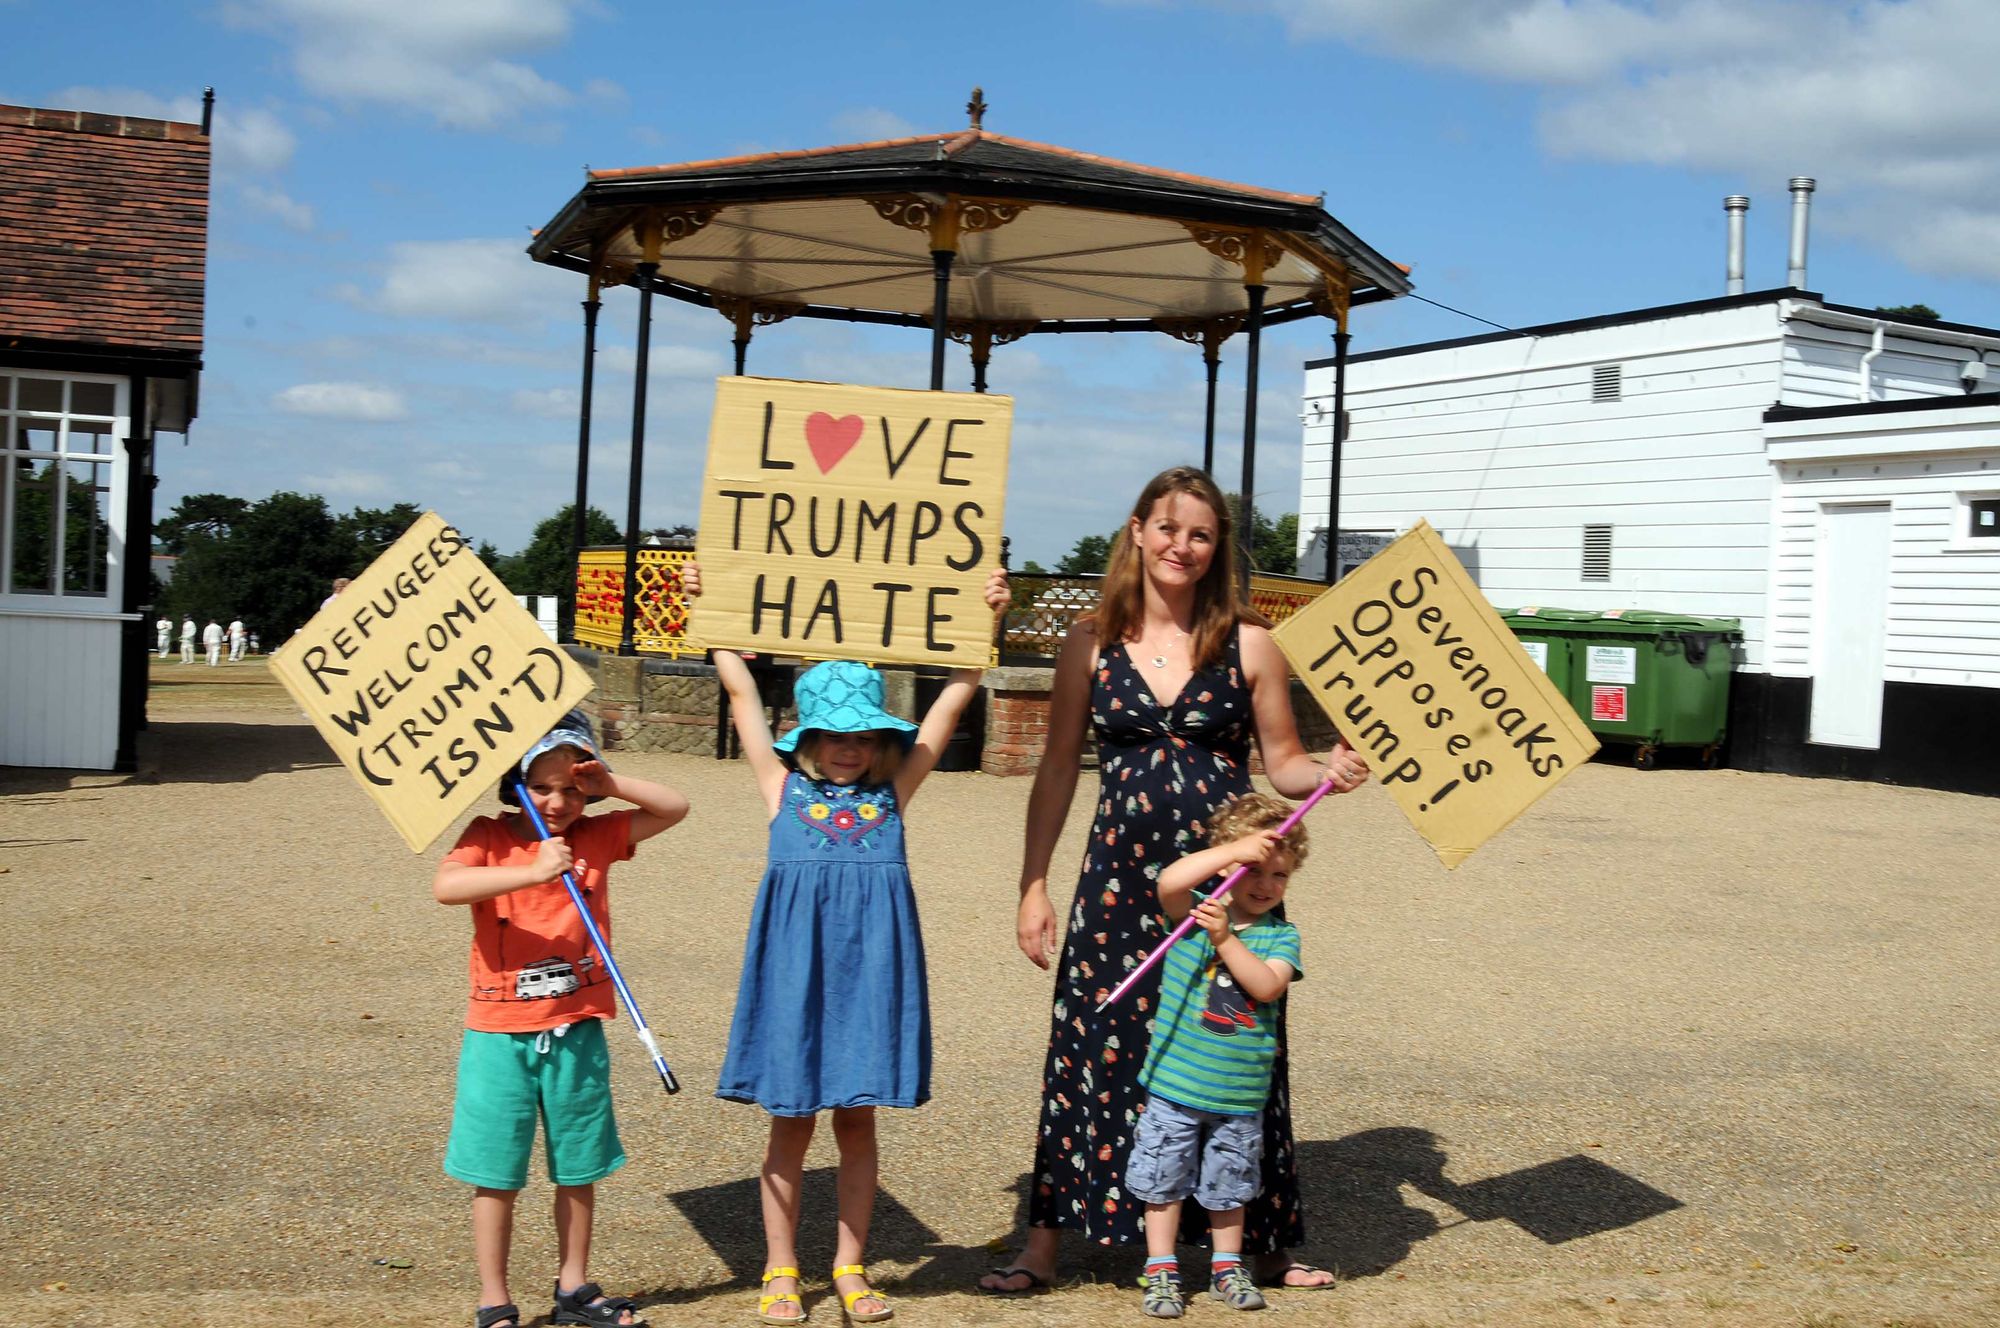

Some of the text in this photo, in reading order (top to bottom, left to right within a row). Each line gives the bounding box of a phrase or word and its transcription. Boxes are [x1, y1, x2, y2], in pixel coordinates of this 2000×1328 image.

[719, 489, 984, 572] TRUMPS
[302, 526, 465, 695] REFUGEES
[331, 576, 496, 737] WELCOME
[752, 573, 959, 652] HATE
[358, 644, 494, 786] (TRUMP
[421, 647, 563, 799] ISN'T)
